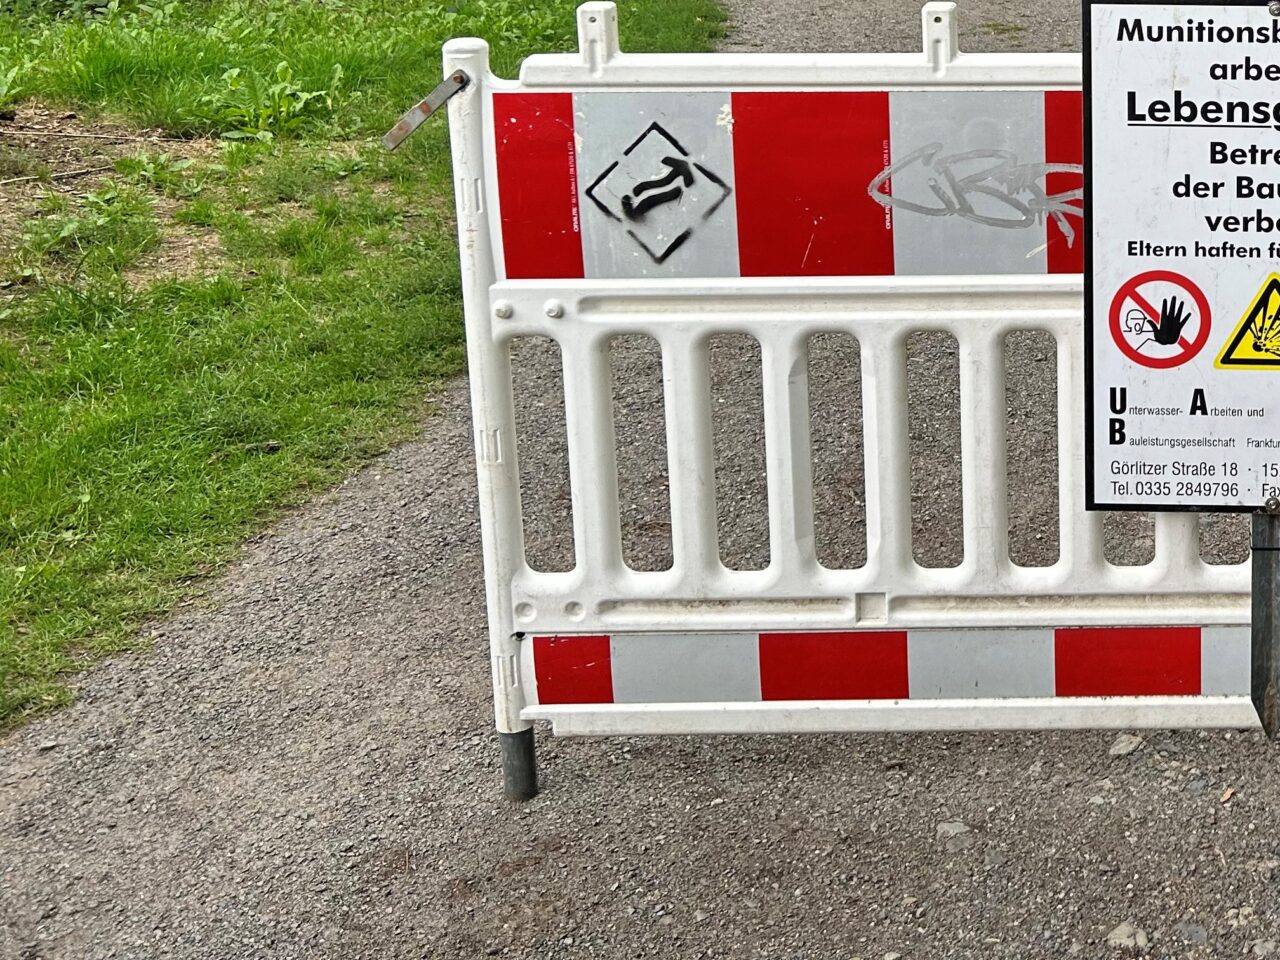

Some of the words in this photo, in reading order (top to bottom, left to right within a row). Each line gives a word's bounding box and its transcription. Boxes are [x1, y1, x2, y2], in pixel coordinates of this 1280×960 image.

[1173, 174, 1225, 198] der
[1128, 240, 1186, 256] Eltern
[1195, 241, 1260, 258] haften
[1248, 408, 1264, 417] und
[1111, 461, 1167, 475] Görlitzer
[1172, 461, 1215, 476] Straße
[1222, 462, 1237, 476] 18
[1111, 481, 1132, 495] Tel.
[1136, 482, 1170, 495] 0335
[1176, 482, 1238, 497] 2849796
